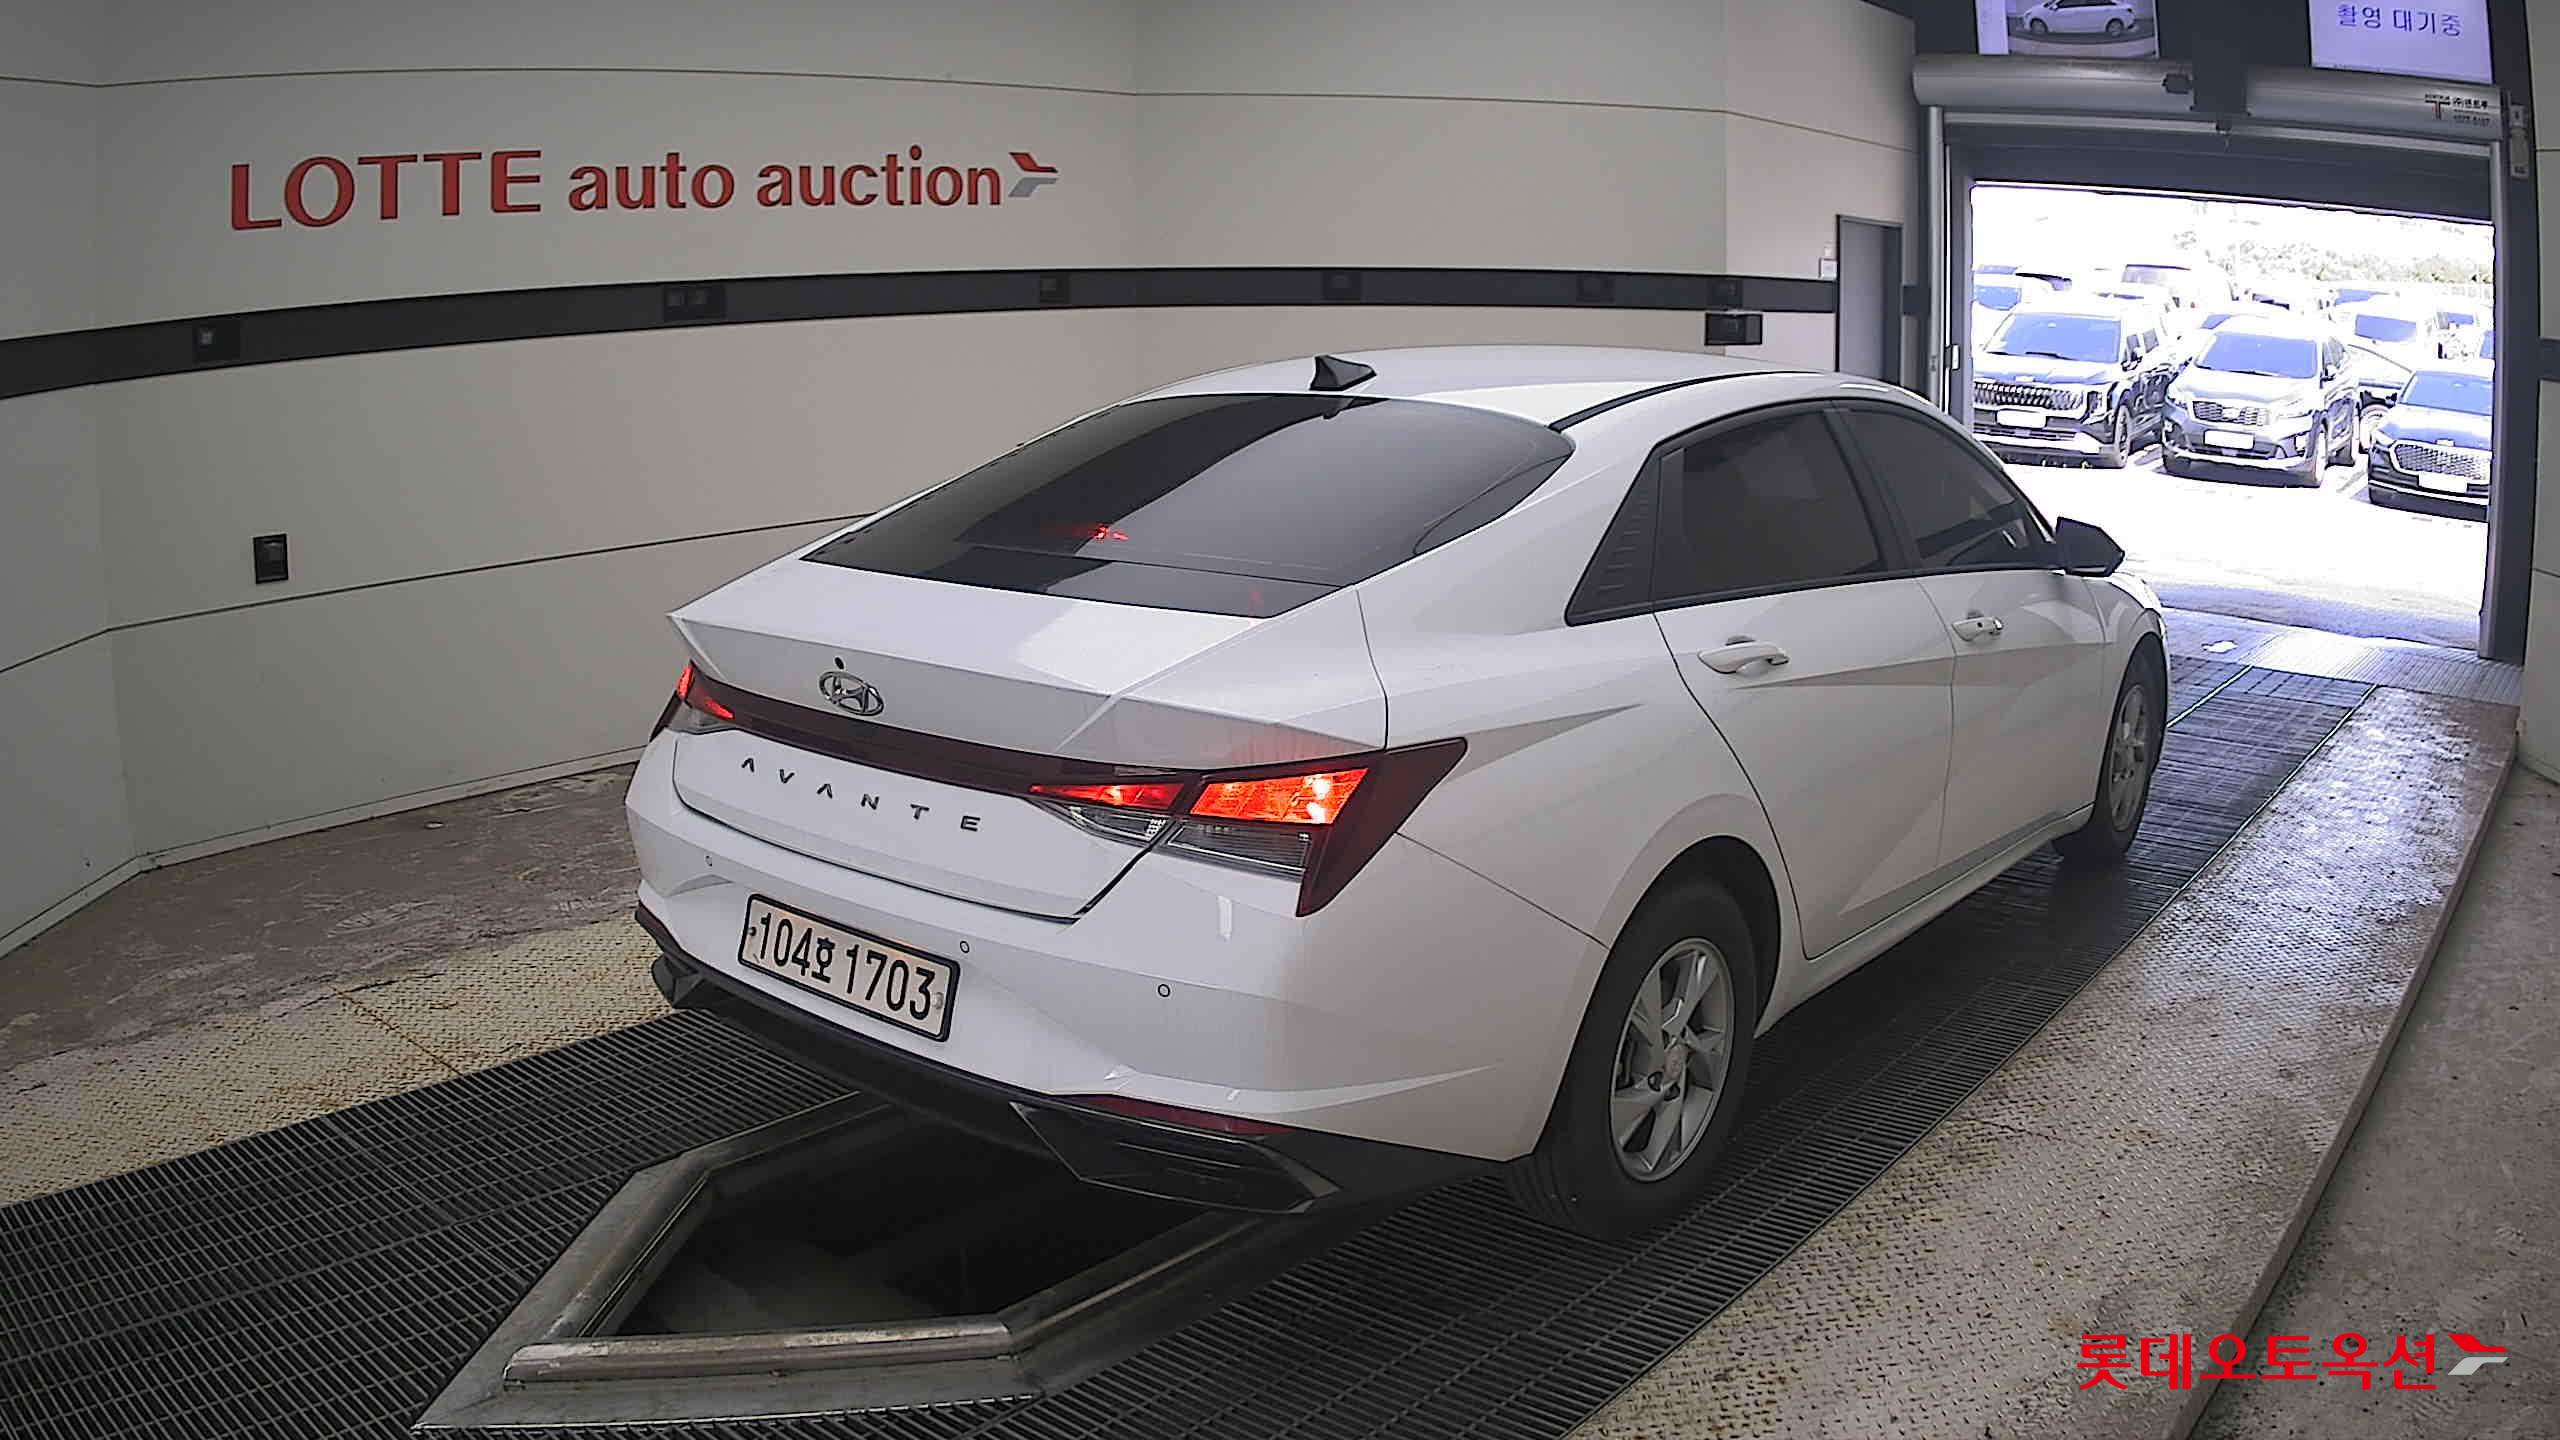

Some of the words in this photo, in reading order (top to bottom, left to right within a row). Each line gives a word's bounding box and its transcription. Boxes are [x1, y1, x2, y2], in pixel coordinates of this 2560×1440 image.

[2337, 3, 2382, 30] 촬영
[2392, 9, 2461, 37] 대기중
[231, 150, 542, 231] LOTTE
[569, 152, 734, 210] auto
[756, 146, 1002, 206] auction
[741, 756, 981, 833] AVANTE
[845, 943, 937, 1021] 1703
